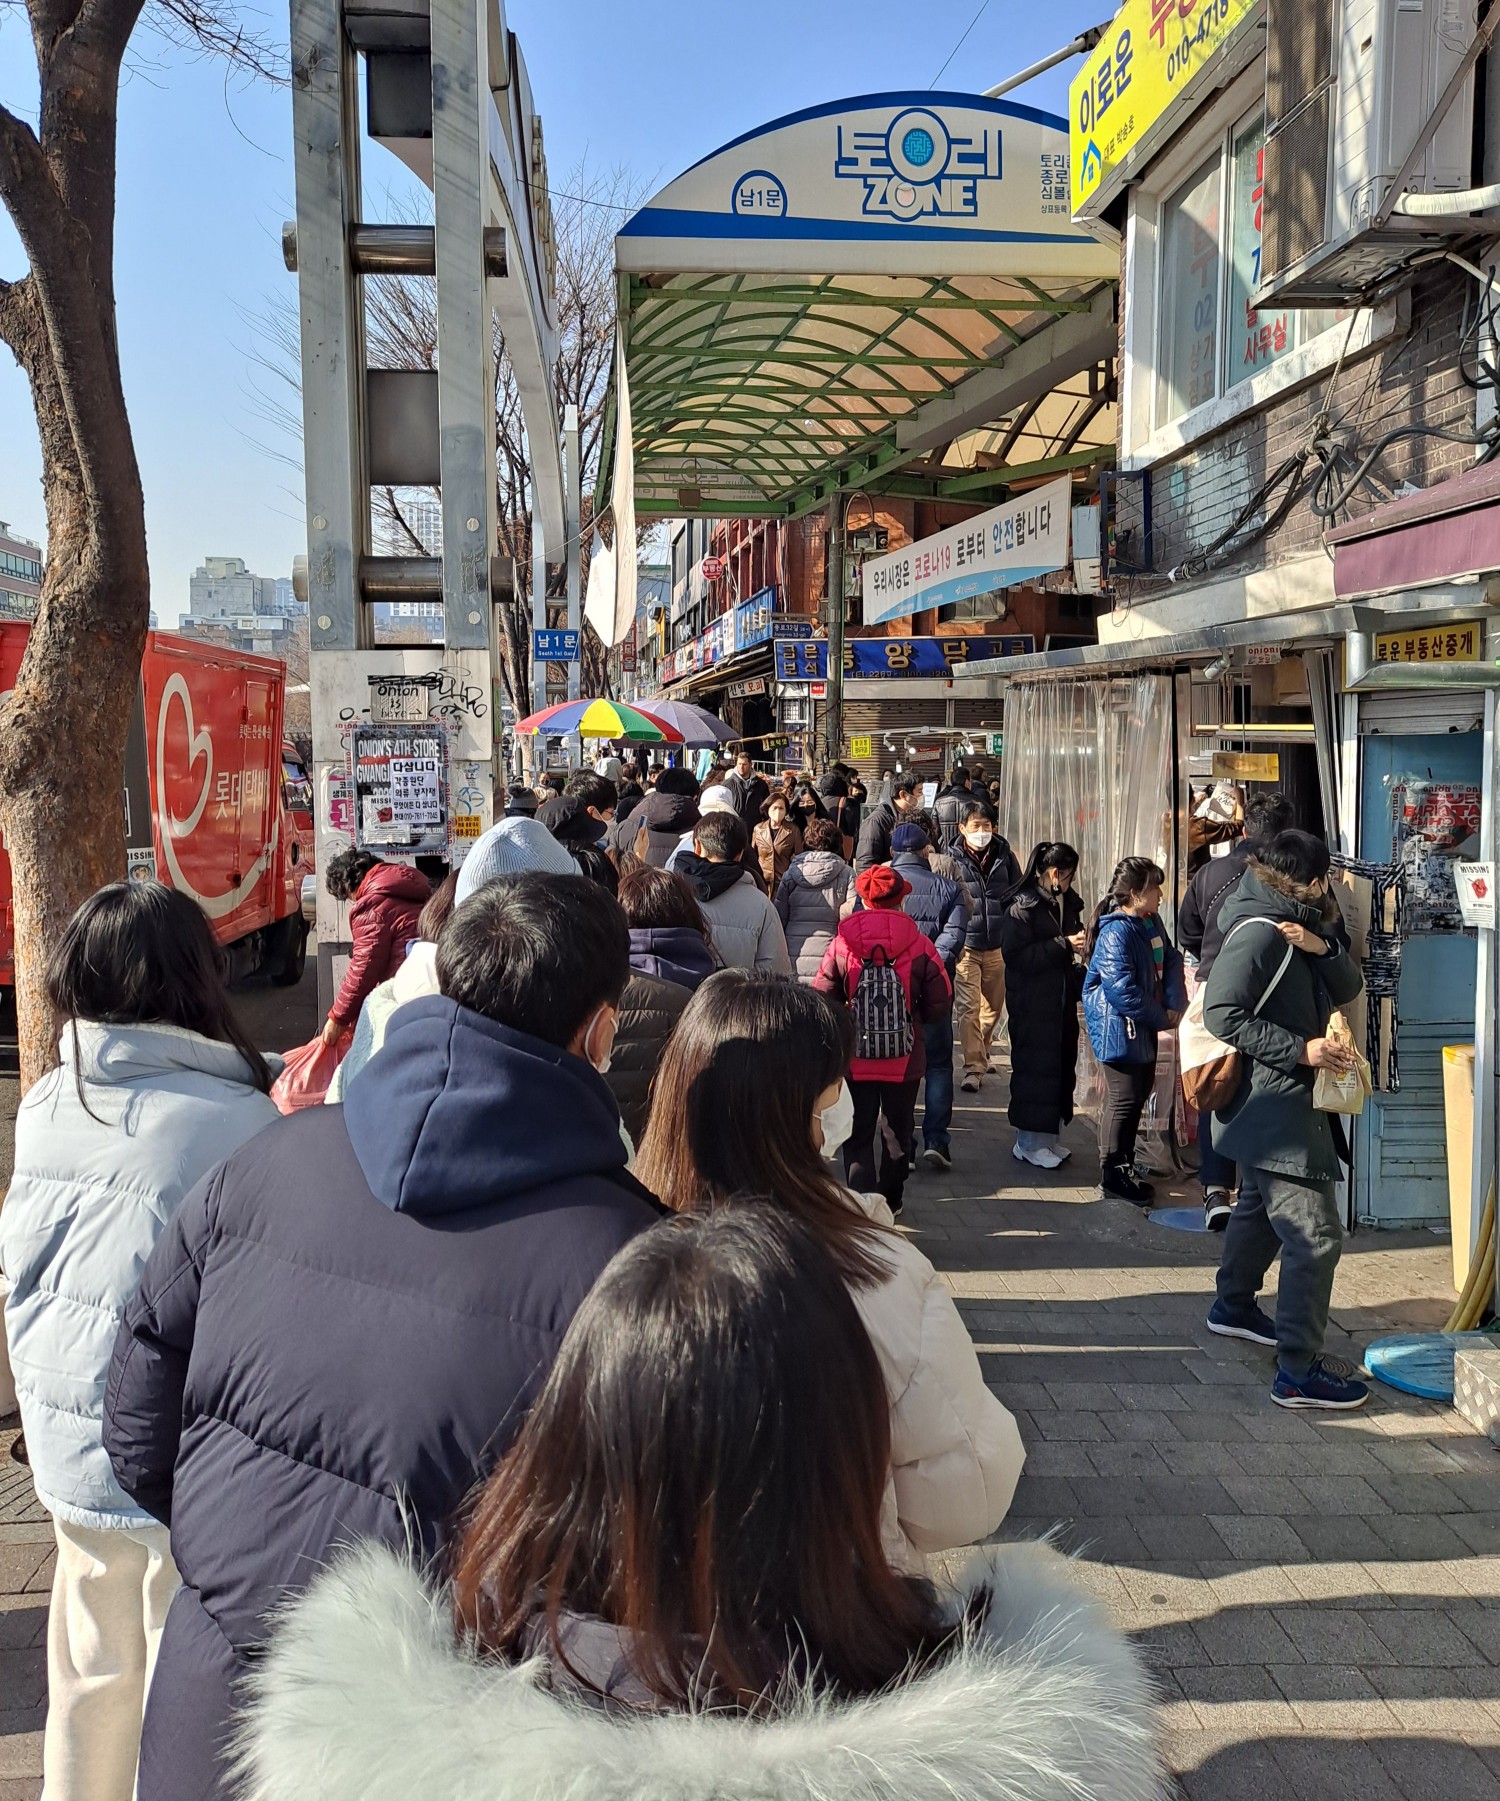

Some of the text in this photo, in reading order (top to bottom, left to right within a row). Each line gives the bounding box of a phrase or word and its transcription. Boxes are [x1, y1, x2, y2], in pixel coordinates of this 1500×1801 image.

[1080, 29, 1133, 134] 이로운
[740, 188, 782, 208] 남1문
[863, 177, 978, 221] ZONE
[1243, 313, 1288, 365] 사무실
[873, 500, 1052, 597] 우리시장은 코로나19 로부터 안전합니다
[1404, 630, 1474, 662] 부동산중개
[783, 661, 819, 676] 보석
[390, 698, 402, 709] is
[357, 738, 441, 759] ONION'S 4TH STORE
[215, 768, 271, 821] 롯데택배
